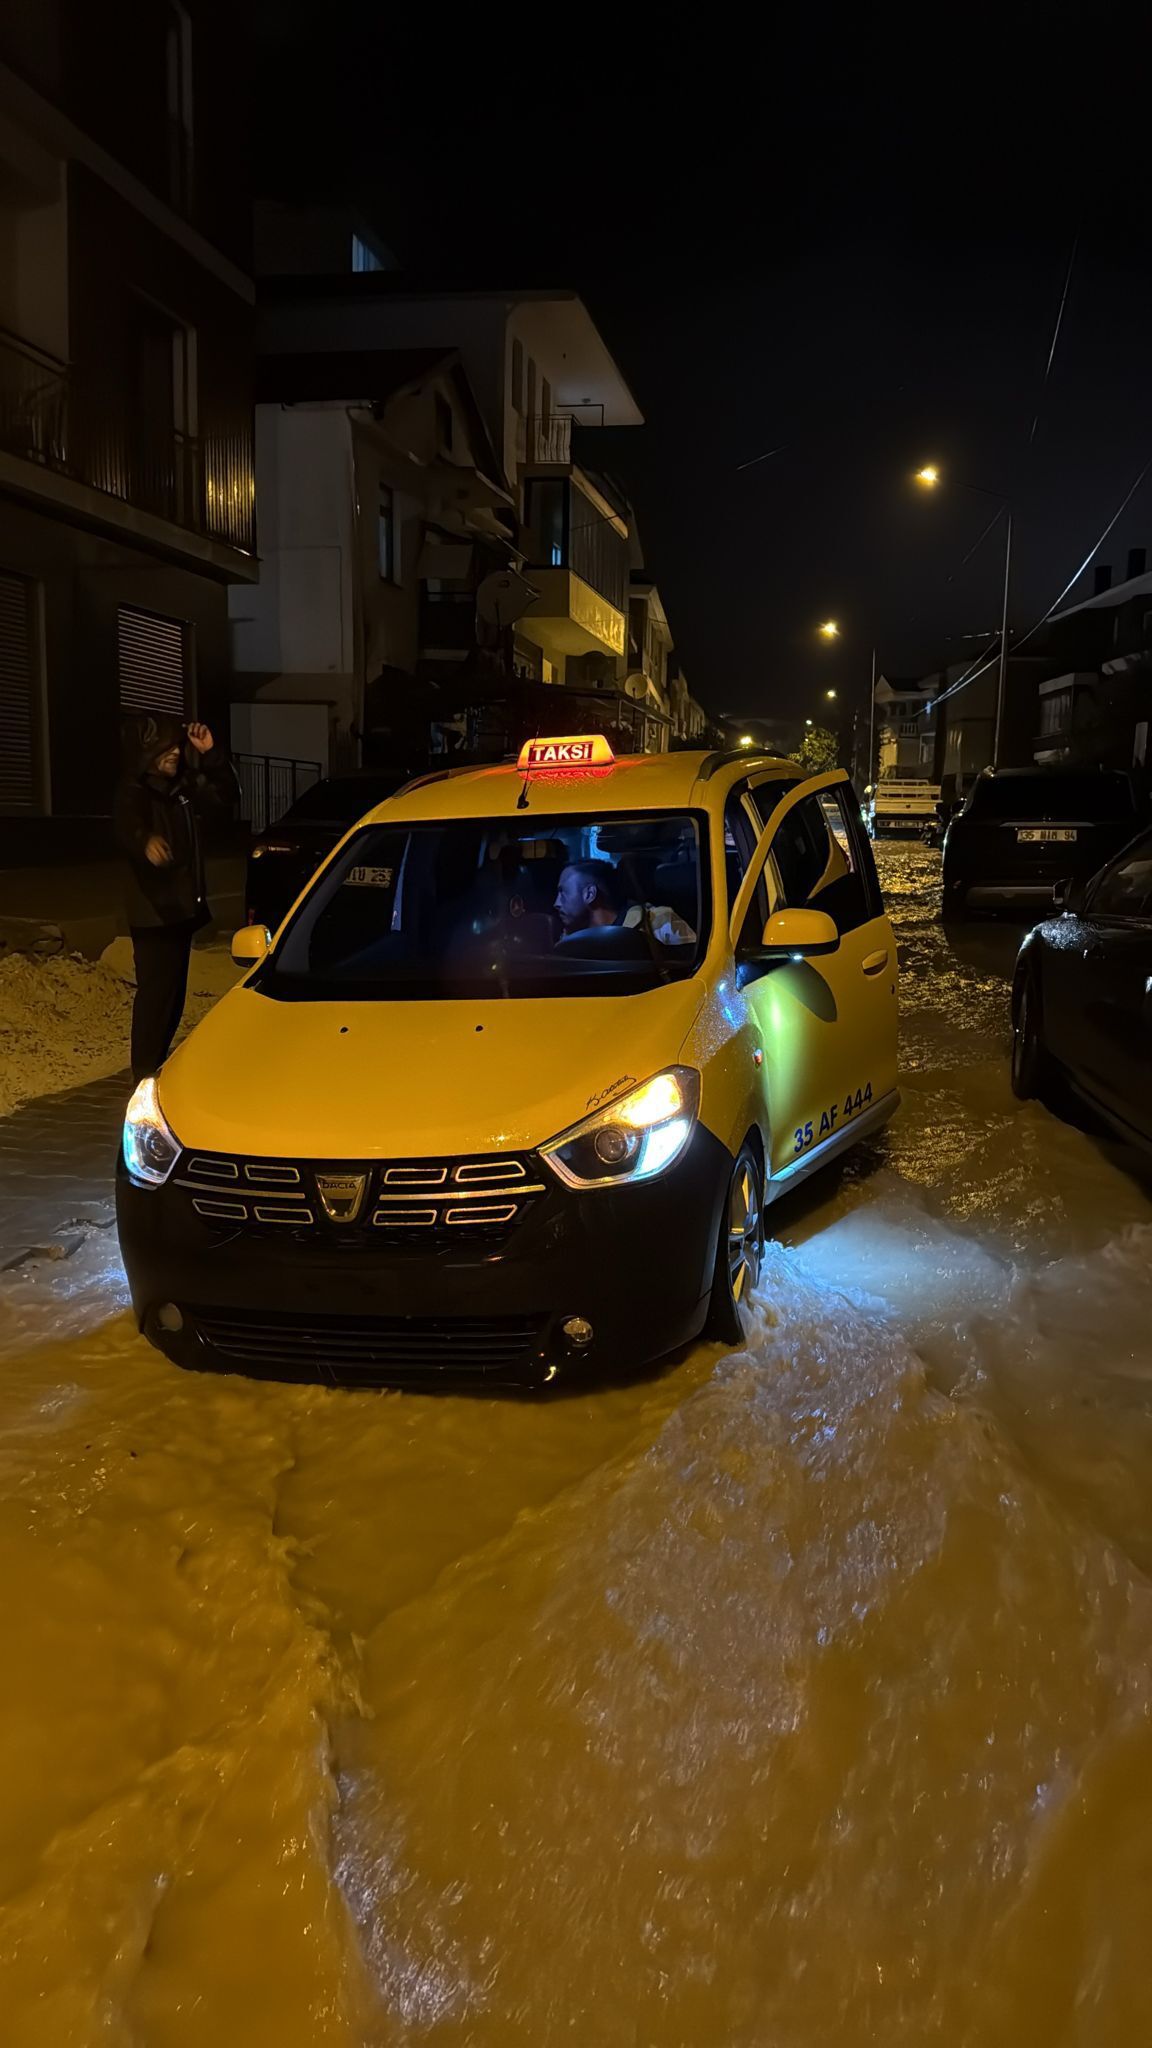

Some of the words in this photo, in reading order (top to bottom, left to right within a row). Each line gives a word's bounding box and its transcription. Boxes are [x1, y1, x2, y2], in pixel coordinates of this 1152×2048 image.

[794, 1121, 813, 1153] 35
[819, 1104, 838, 1136] AF
[843, 1082, 873, 1116] 444
[322, 1182, 357, 1190] DACIA
